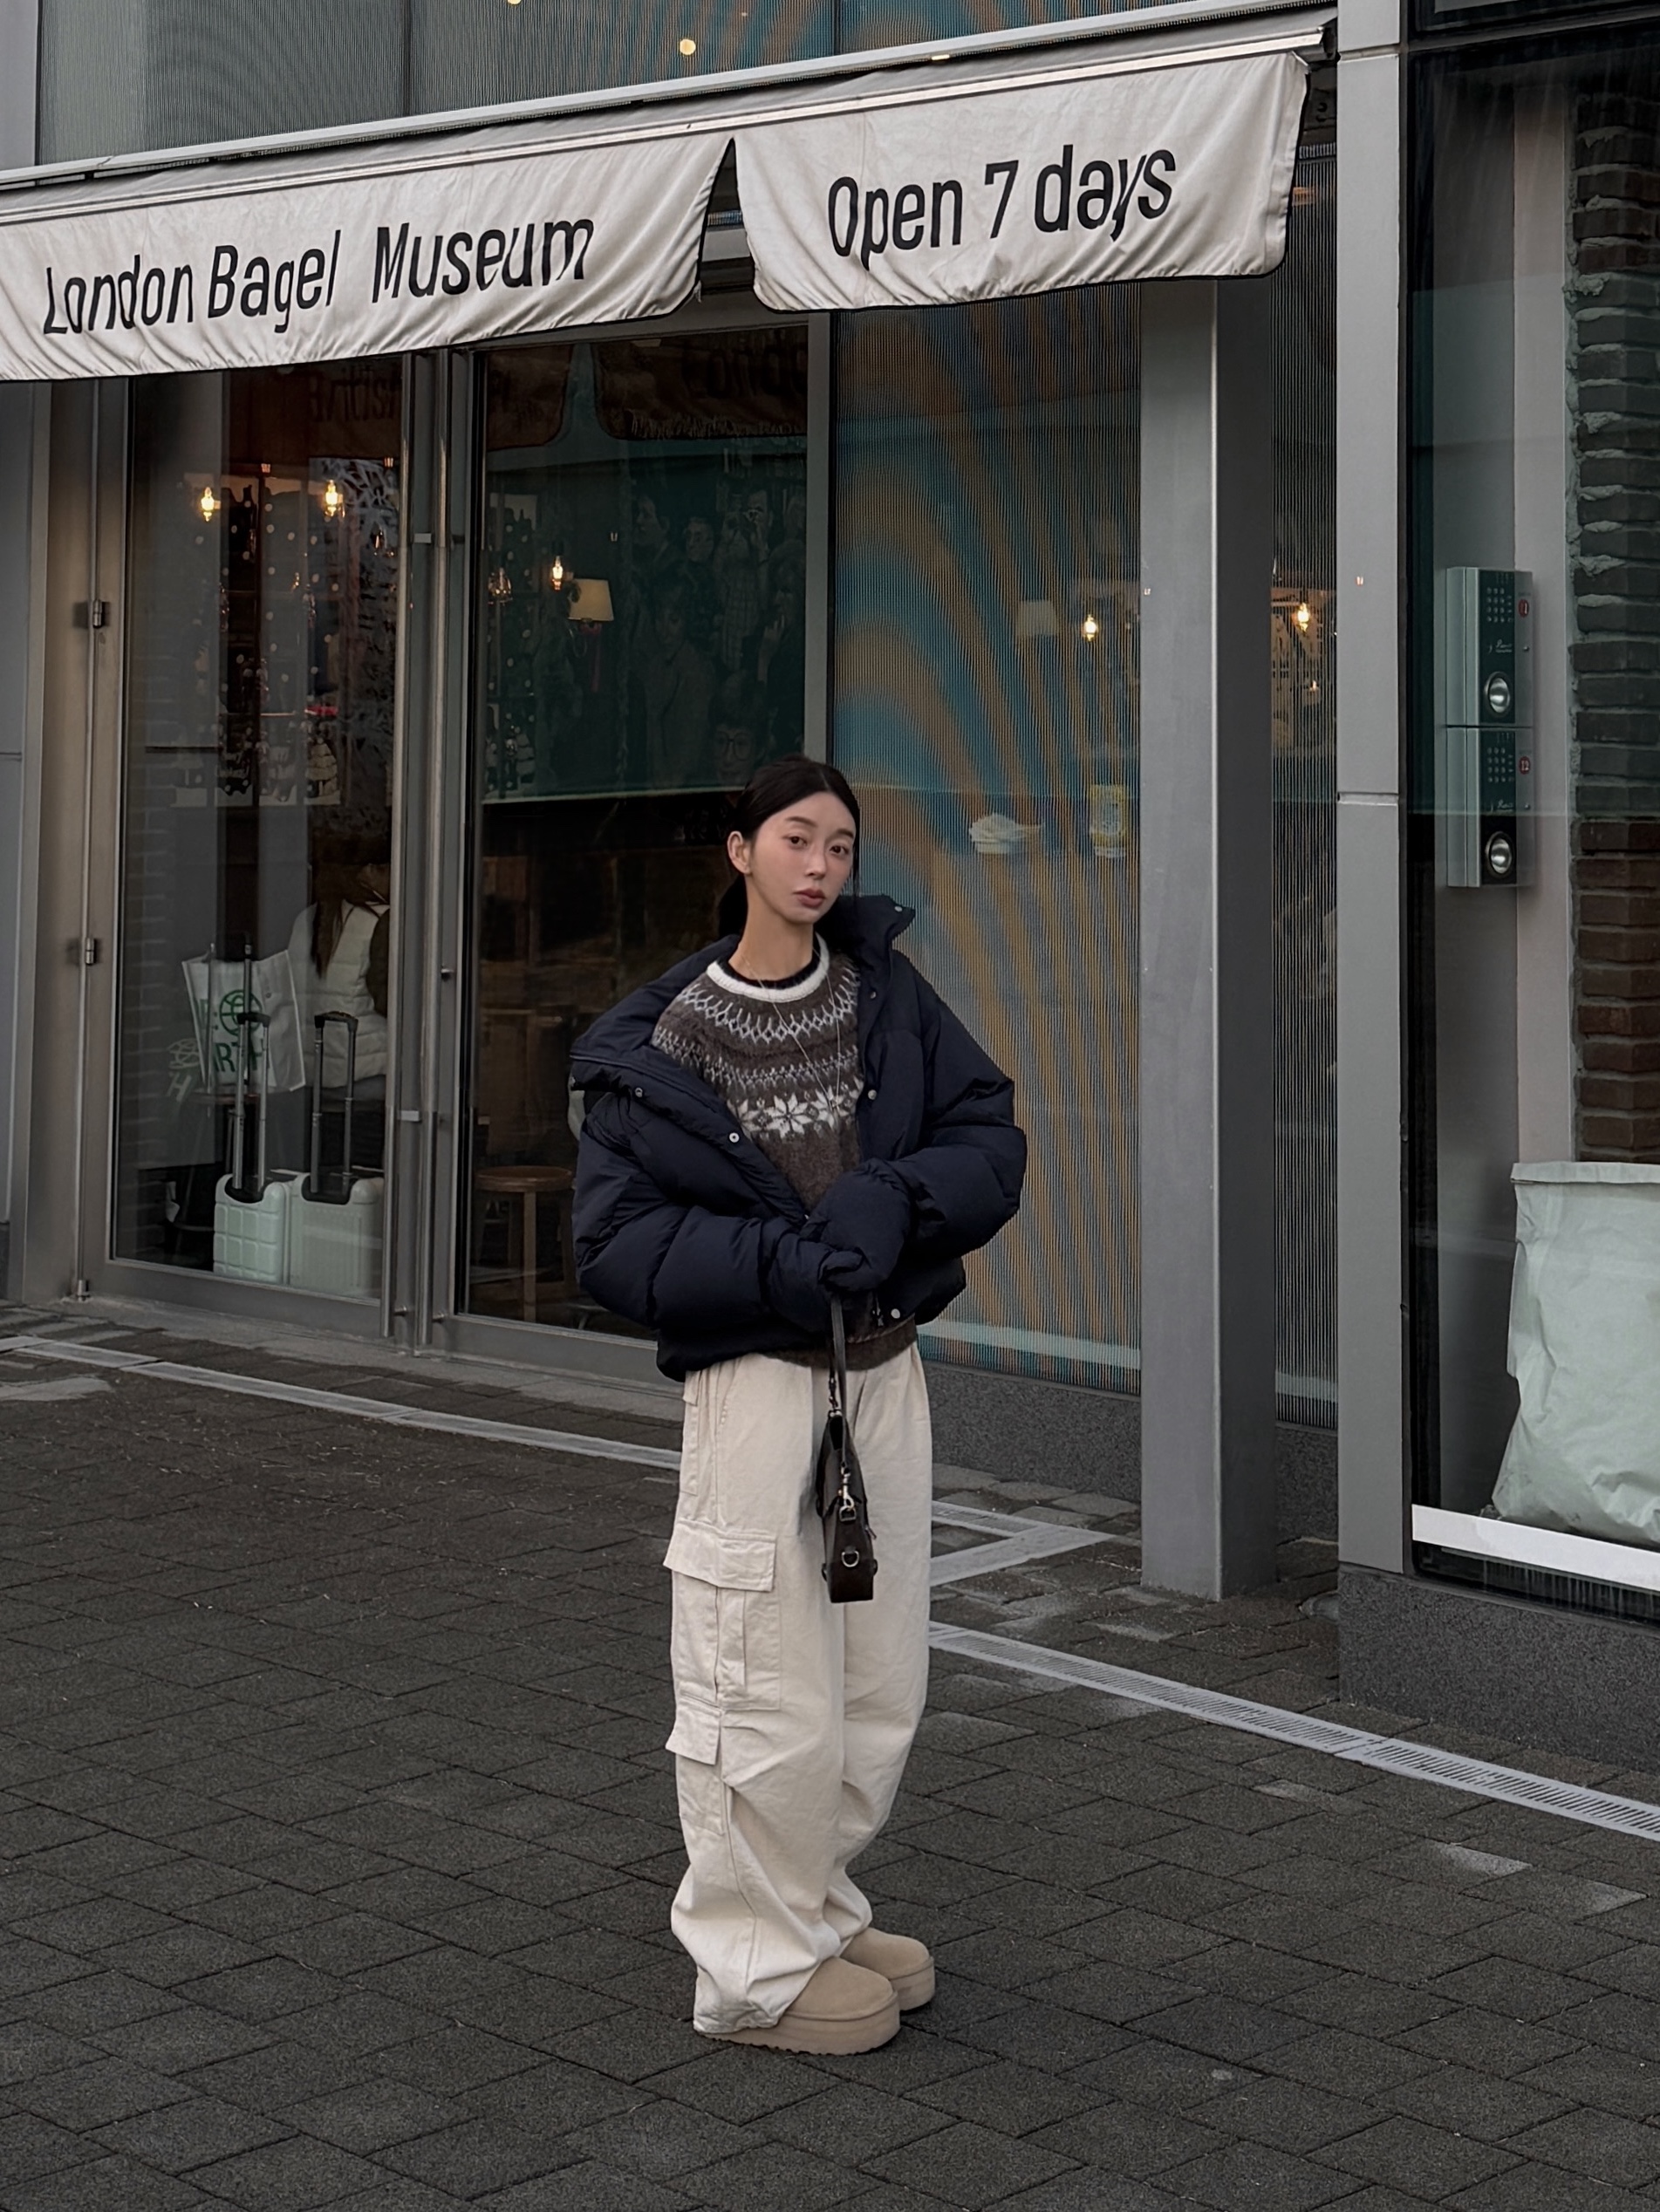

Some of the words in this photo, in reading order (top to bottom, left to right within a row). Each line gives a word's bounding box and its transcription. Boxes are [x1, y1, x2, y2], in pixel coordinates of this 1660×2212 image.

[829, 176, 963, 271] Open
[984, 160, 1019, 239] 7
[1034, 144, 1176, 242] days
[44, 254, 194, 334] London
[208, 229, 341, 333] Bagel
[372, 219, 595, 304] Museum
